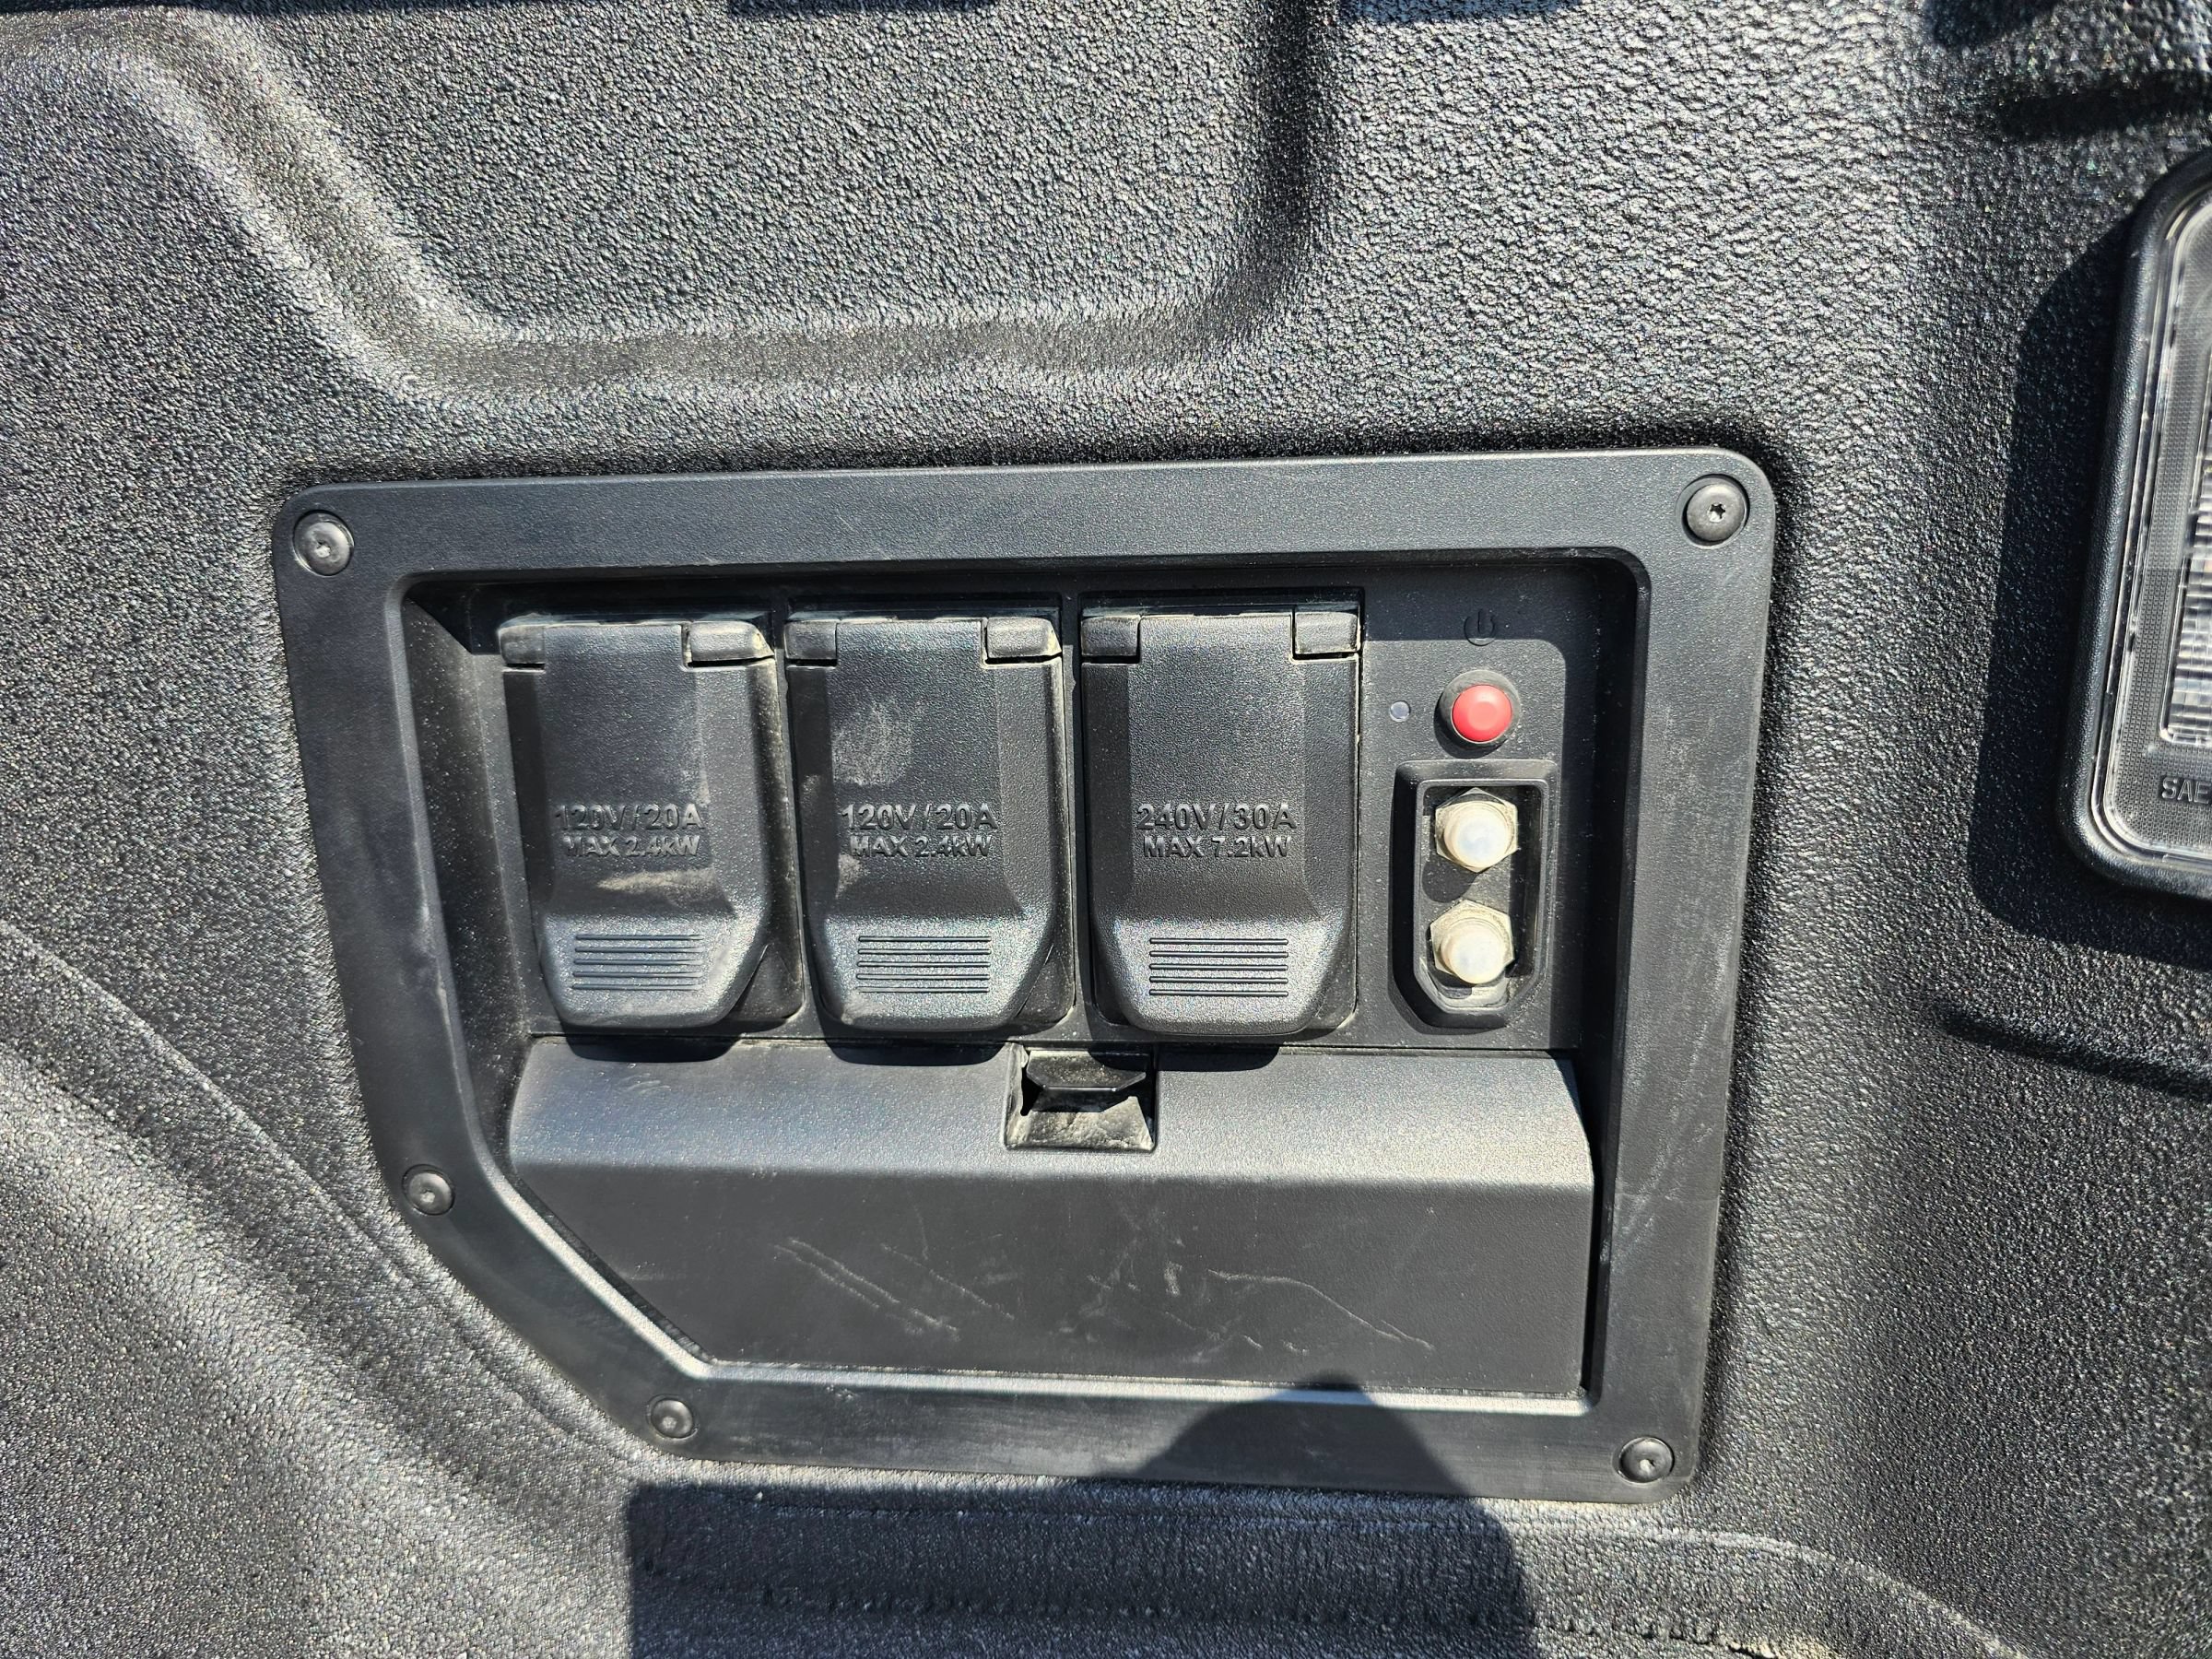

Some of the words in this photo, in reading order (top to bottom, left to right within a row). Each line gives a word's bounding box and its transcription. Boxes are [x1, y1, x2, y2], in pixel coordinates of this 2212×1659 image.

[2161, 776, 2212, 805] SAE
[555, 803, 704, 830] 120V/20A
[841, 803, 998, 830] 120V/20A
[1136, 803, 1297, 830] 240V/30A
[562, 835, 620, 857] MAX
[850, 835, 909, 857] MAX
[1143, 835, 1205, 858] MAX
